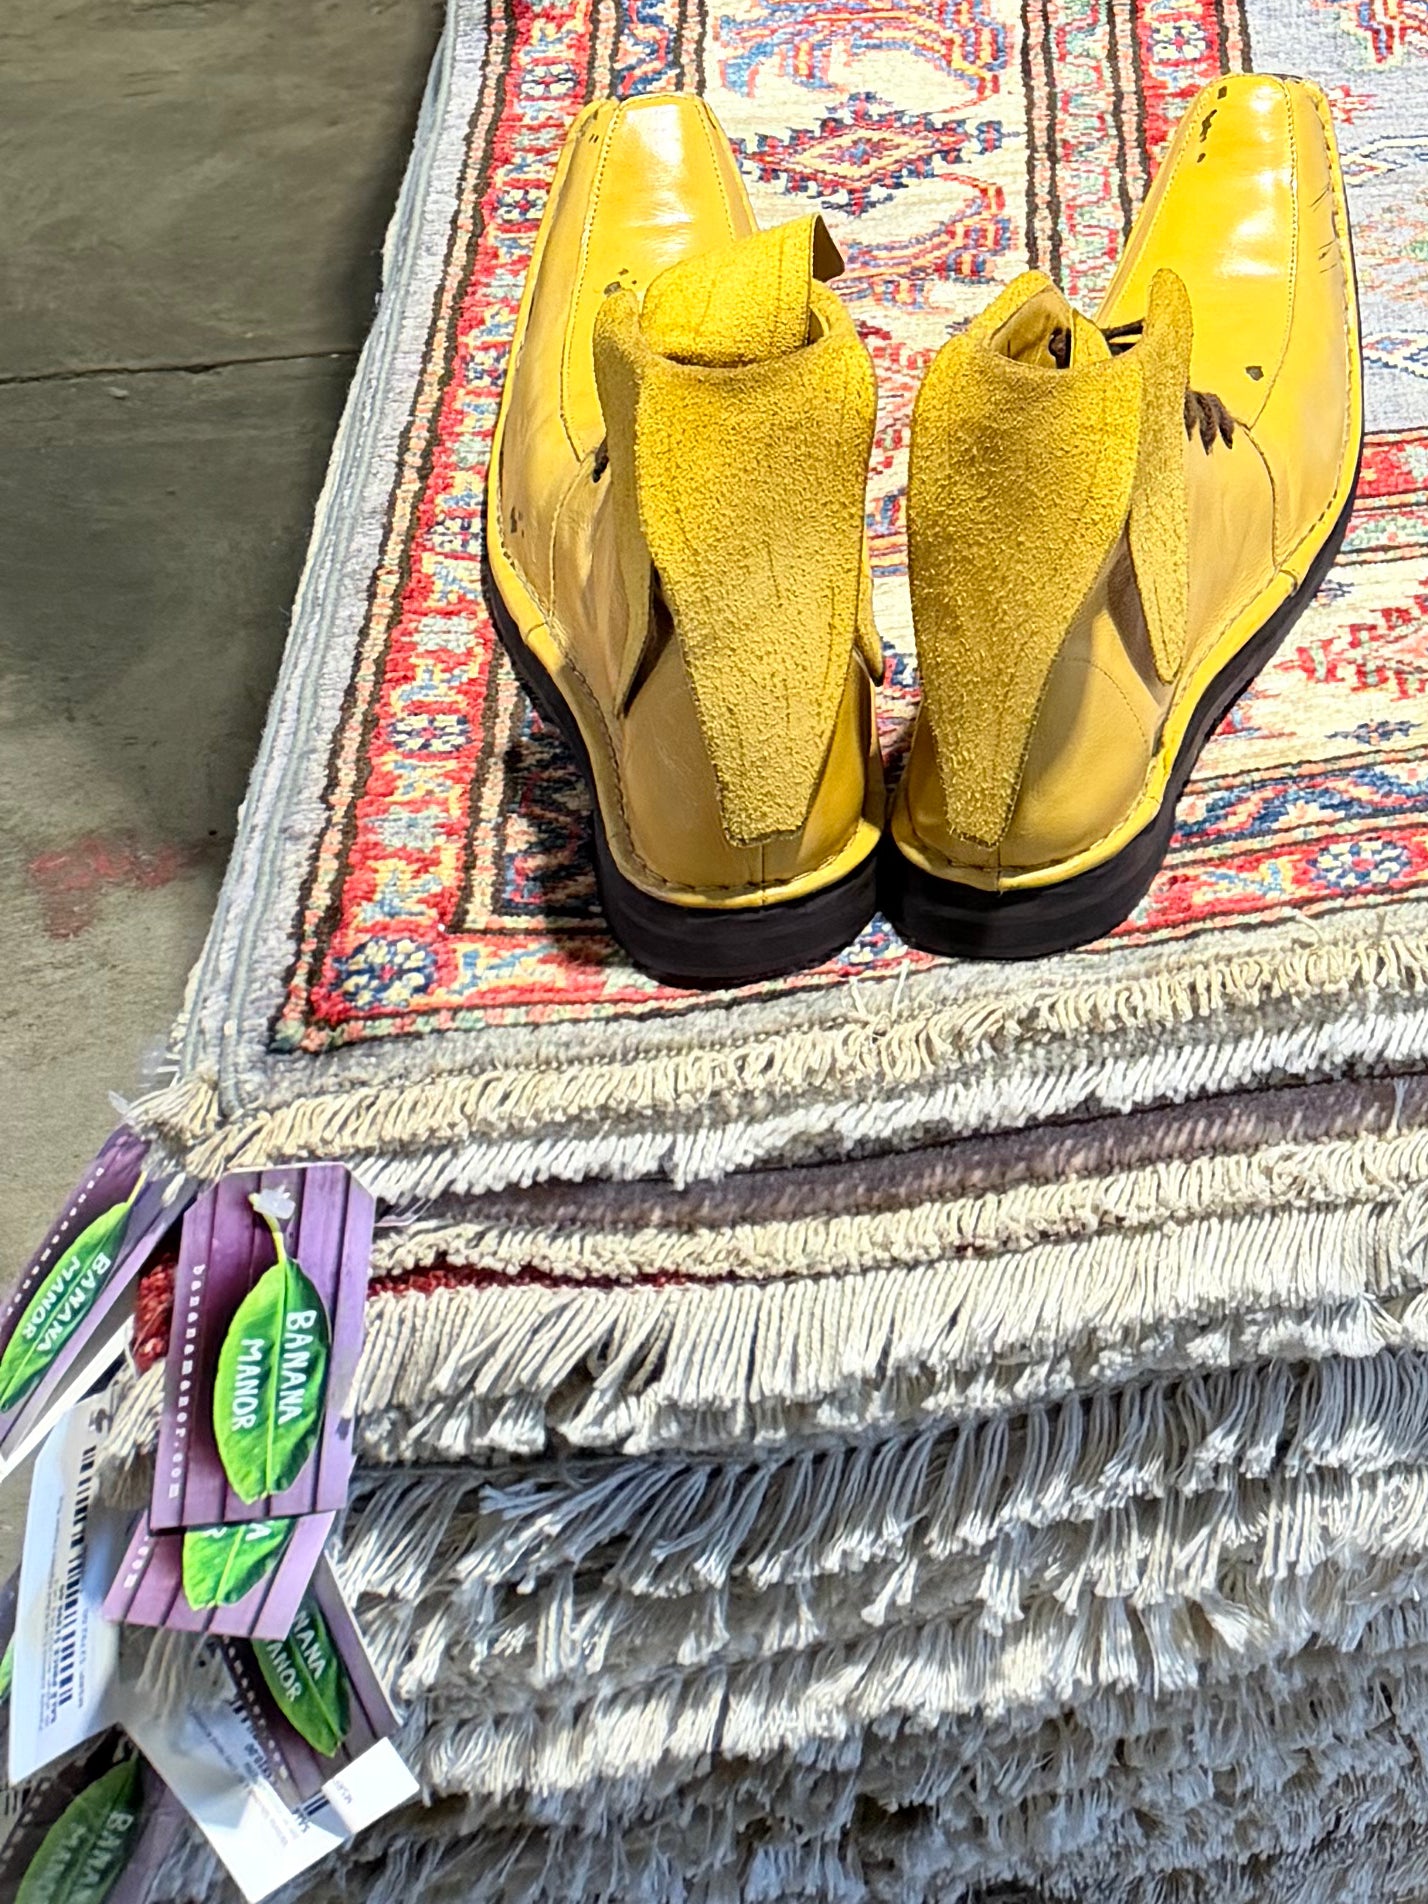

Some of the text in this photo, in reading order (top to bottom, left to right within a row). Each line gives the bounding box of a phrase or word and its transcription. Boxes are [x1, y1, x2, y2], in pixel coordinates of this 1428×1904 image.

[22, 1255, 81, 1339] MANOR
[35, 1252, 111, 1352] BANANA
[169, 1264, 205, 1499] bananamanor.com
[231, 1338, 265, 1432] MANOR
[278, 1309, 317, 1425] BANANA
[267, 1642, 302, 1702] ANOR
[293, 1610, 327, 1681] NANA
